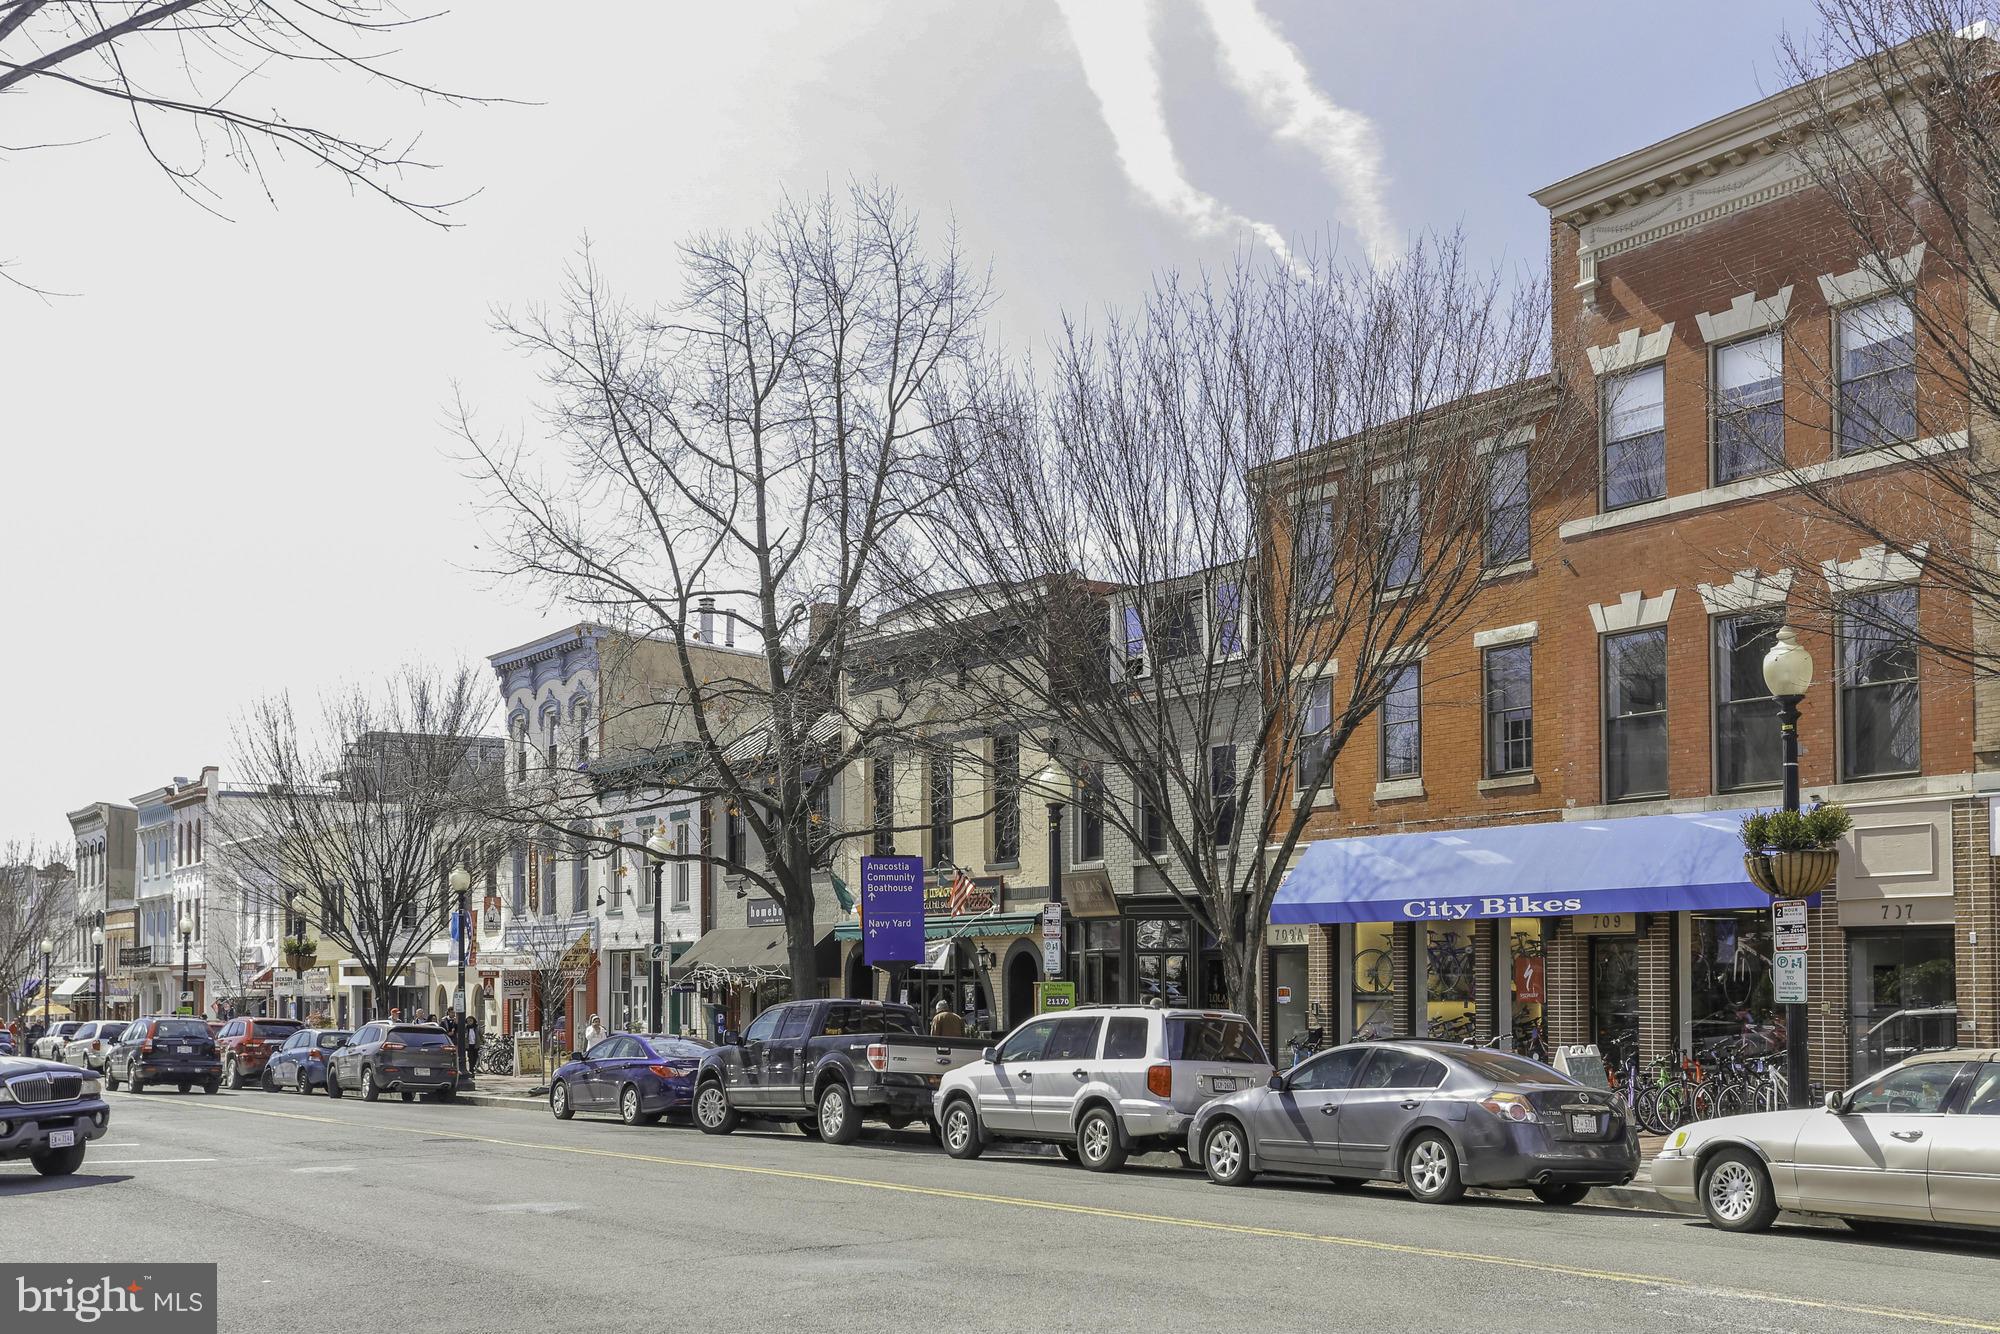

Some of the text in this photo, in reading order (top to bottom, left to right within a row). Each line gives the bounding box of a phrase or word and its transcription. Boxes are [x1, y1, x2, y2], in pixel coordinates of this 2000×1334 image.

[867, 862, 910, 871] Anacostia
[867, 873, 915, 882] Community
[867, 884, 913, 892] Boathouse
[750, 904, 783, 918] homebo
[1403, 896, 1582, 920] City Bikes
[1776, 909, 1782, 917] 2
[868, 919, 912, 929] Navy Yard
[1592, 914, 1621, 928] 709
[503, 979, 531, 987] SHOPS
[310, 985, 324, 994] Shop
[1208, 993, 1227, 1003] LOLA
[717, 1013, 724, 1023] P
